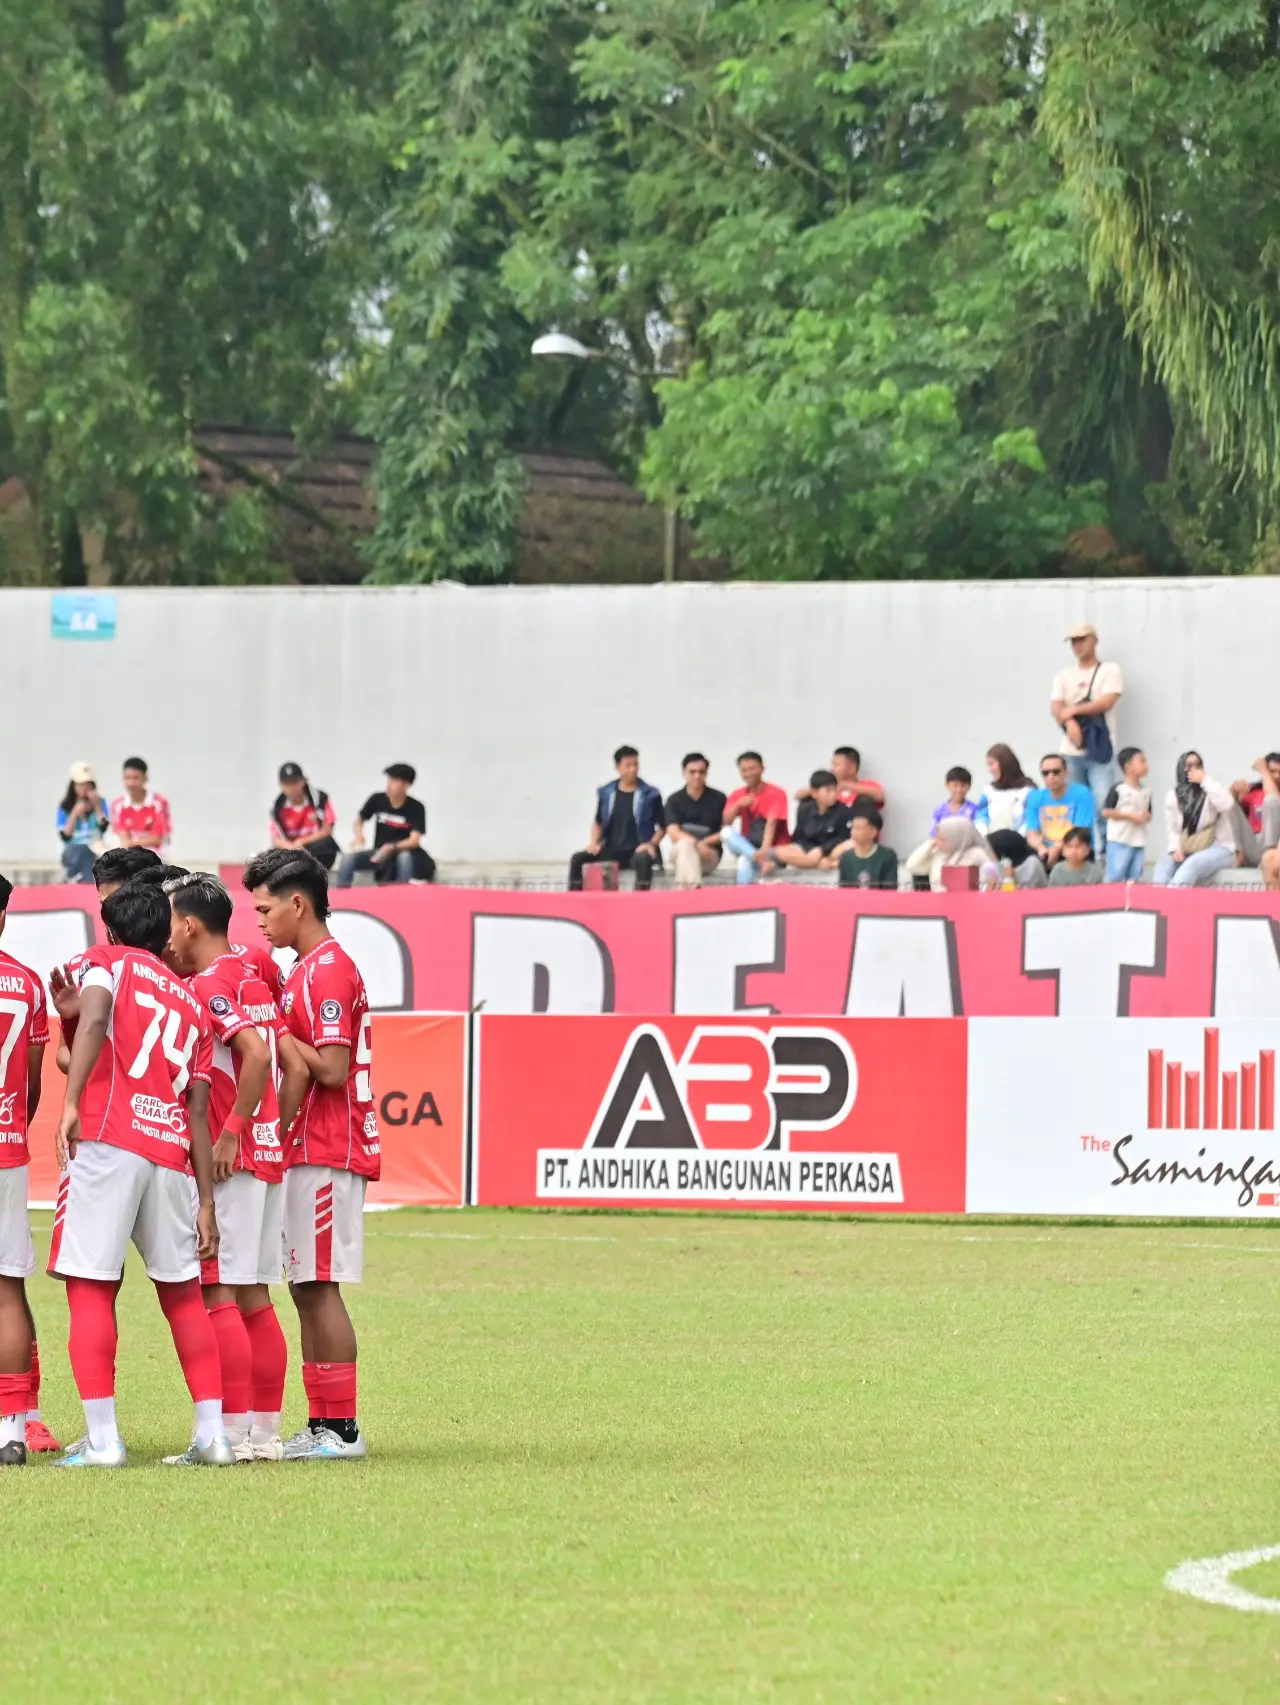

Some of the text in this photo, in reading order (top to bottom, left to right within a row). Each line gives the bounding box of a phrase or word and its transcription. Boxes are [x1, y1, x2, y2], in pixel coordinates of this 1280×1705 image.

[128, 990, 199, 1099] 74
[134, 1103, 168, 1120] EMAS
[589, 1030, 852, 1150] ABP
[544, 1158, 895, 1194] PT. ANDHIKA BANGUNAN PERKASA
[1081, 1134, 1280, 1207] The Saminga
